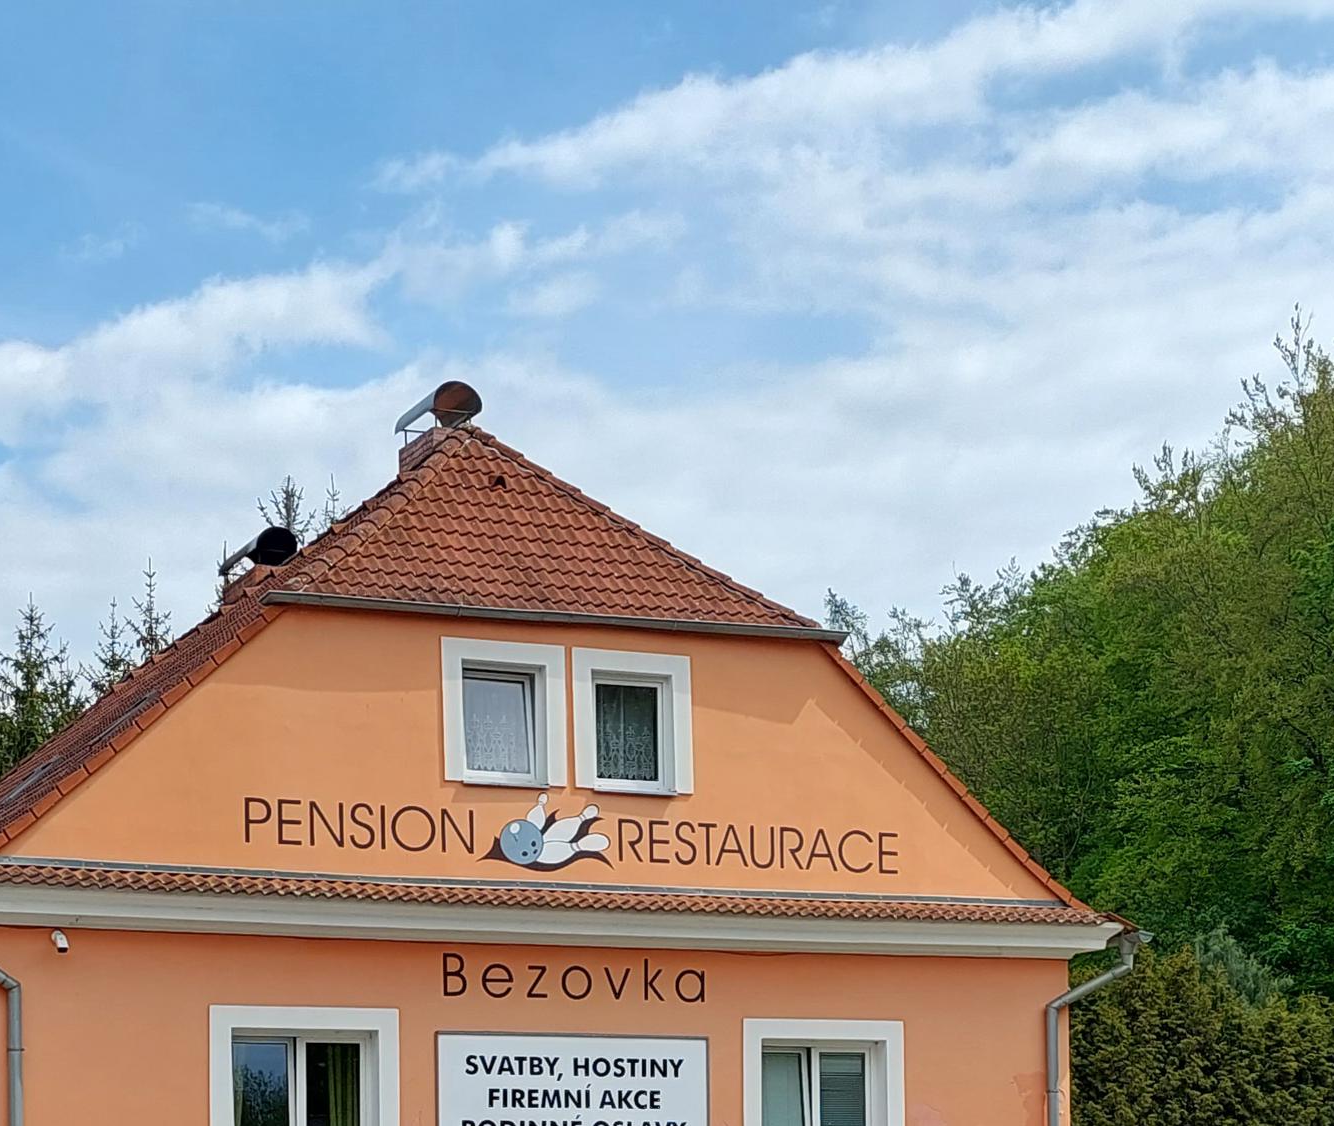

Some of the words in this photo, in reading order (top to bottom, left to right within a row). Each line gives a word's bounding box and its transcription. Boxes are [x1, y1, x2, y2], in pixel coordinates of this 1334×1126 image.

[244, 797, 475, 855] PENSION
[617, 818, 899, 875] RESTAURACE
[441, 952, 706, 1003] Bezovka
[465, 1054, 564, 1082] SVATBY,
[573, 1057, 685, 1079] HOSTINY
[488, 1082, 591, 1109] FIREMNÍ
[599, 1089, 661, 1110] AKCE
